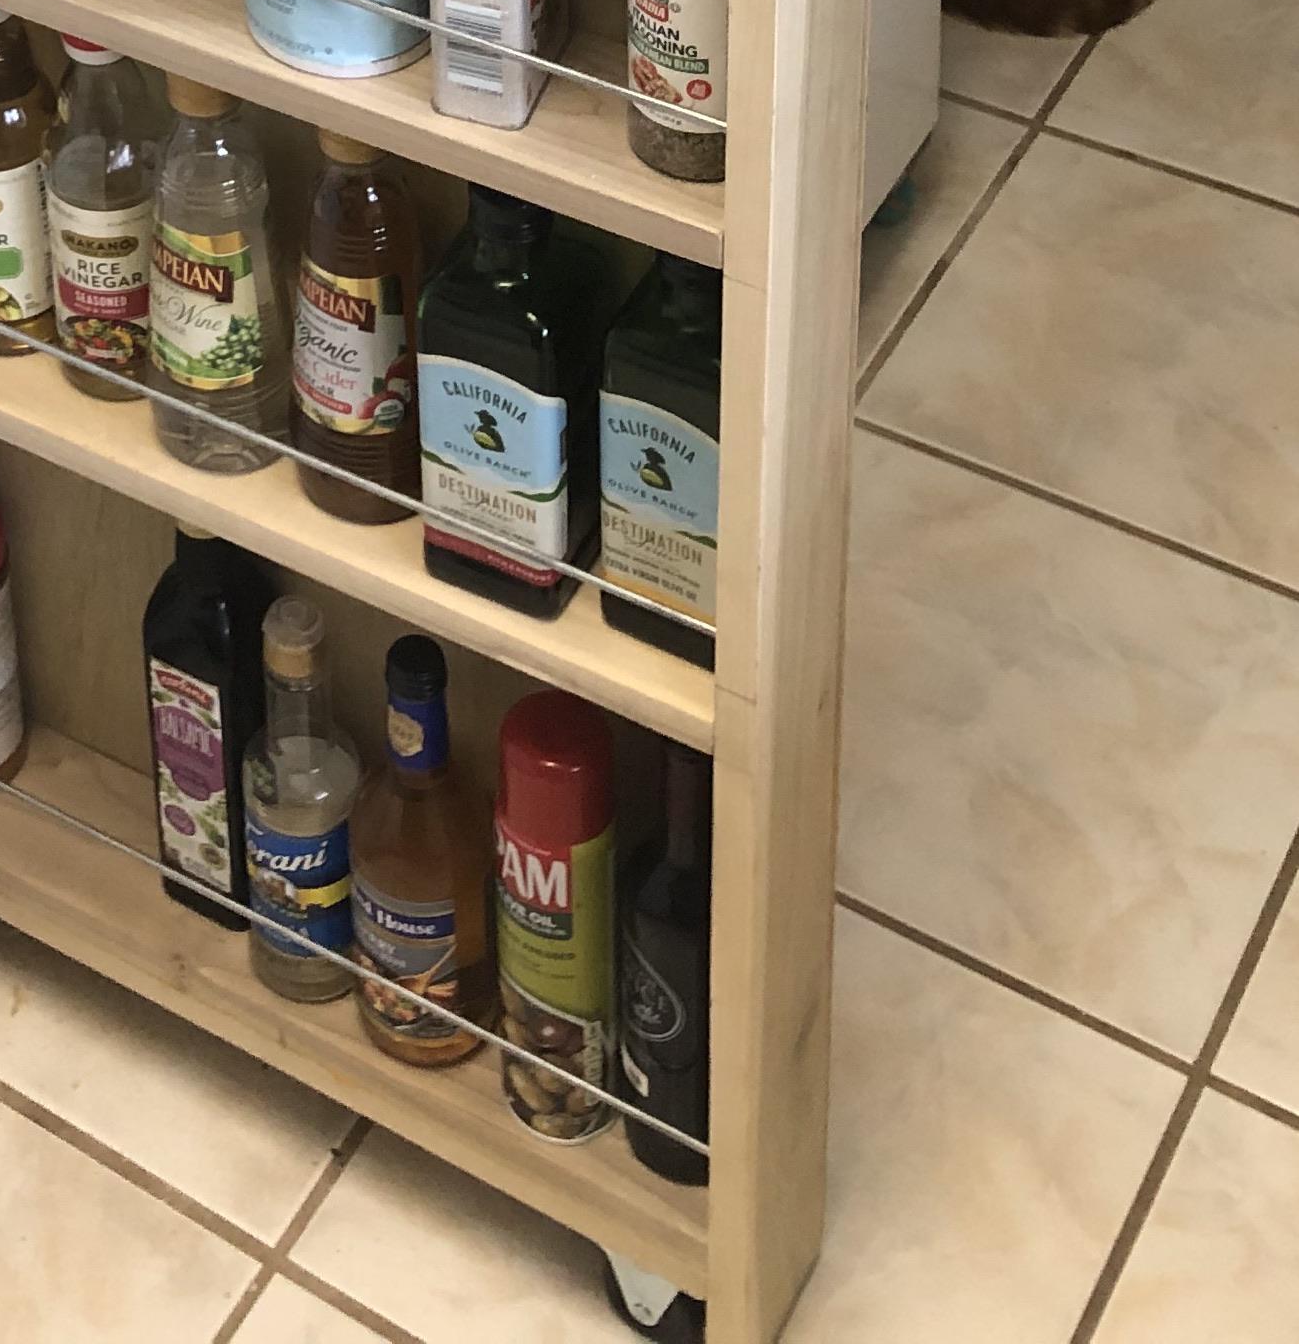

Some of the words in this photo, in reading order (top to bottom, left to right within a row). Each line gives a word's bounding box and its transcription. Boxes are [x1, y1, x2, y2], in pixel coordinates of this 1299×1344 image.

[632, 6, 680, 41] ITALIAN
[673, 57, 706, 74] BLEND
[63, 266, 143, 289] VINEGAR
[77, 259, 121, 275] RICE
[74, 290, 127, 307] SEASONED
[167, 295, 224, 331] Wine
[312, 361, 359, 391] Cider
[442, 380, 527, 424] CALIFORNIA
[608, 417, 696, 464] CALIFORNIA
[443, 440, 480, 461] OLIVE
[486, 455, 531, 479] RANCH
[438, 473, 537, 525] DESTINATION
[607, 478, 647, 499] OLIVE
[651, 495, 698, 519] RANCH
[602, 511, 703, 566] DESTINATION
[632, 566, 661, 586] VIRGIN
[376, 910, 437, 936] House
